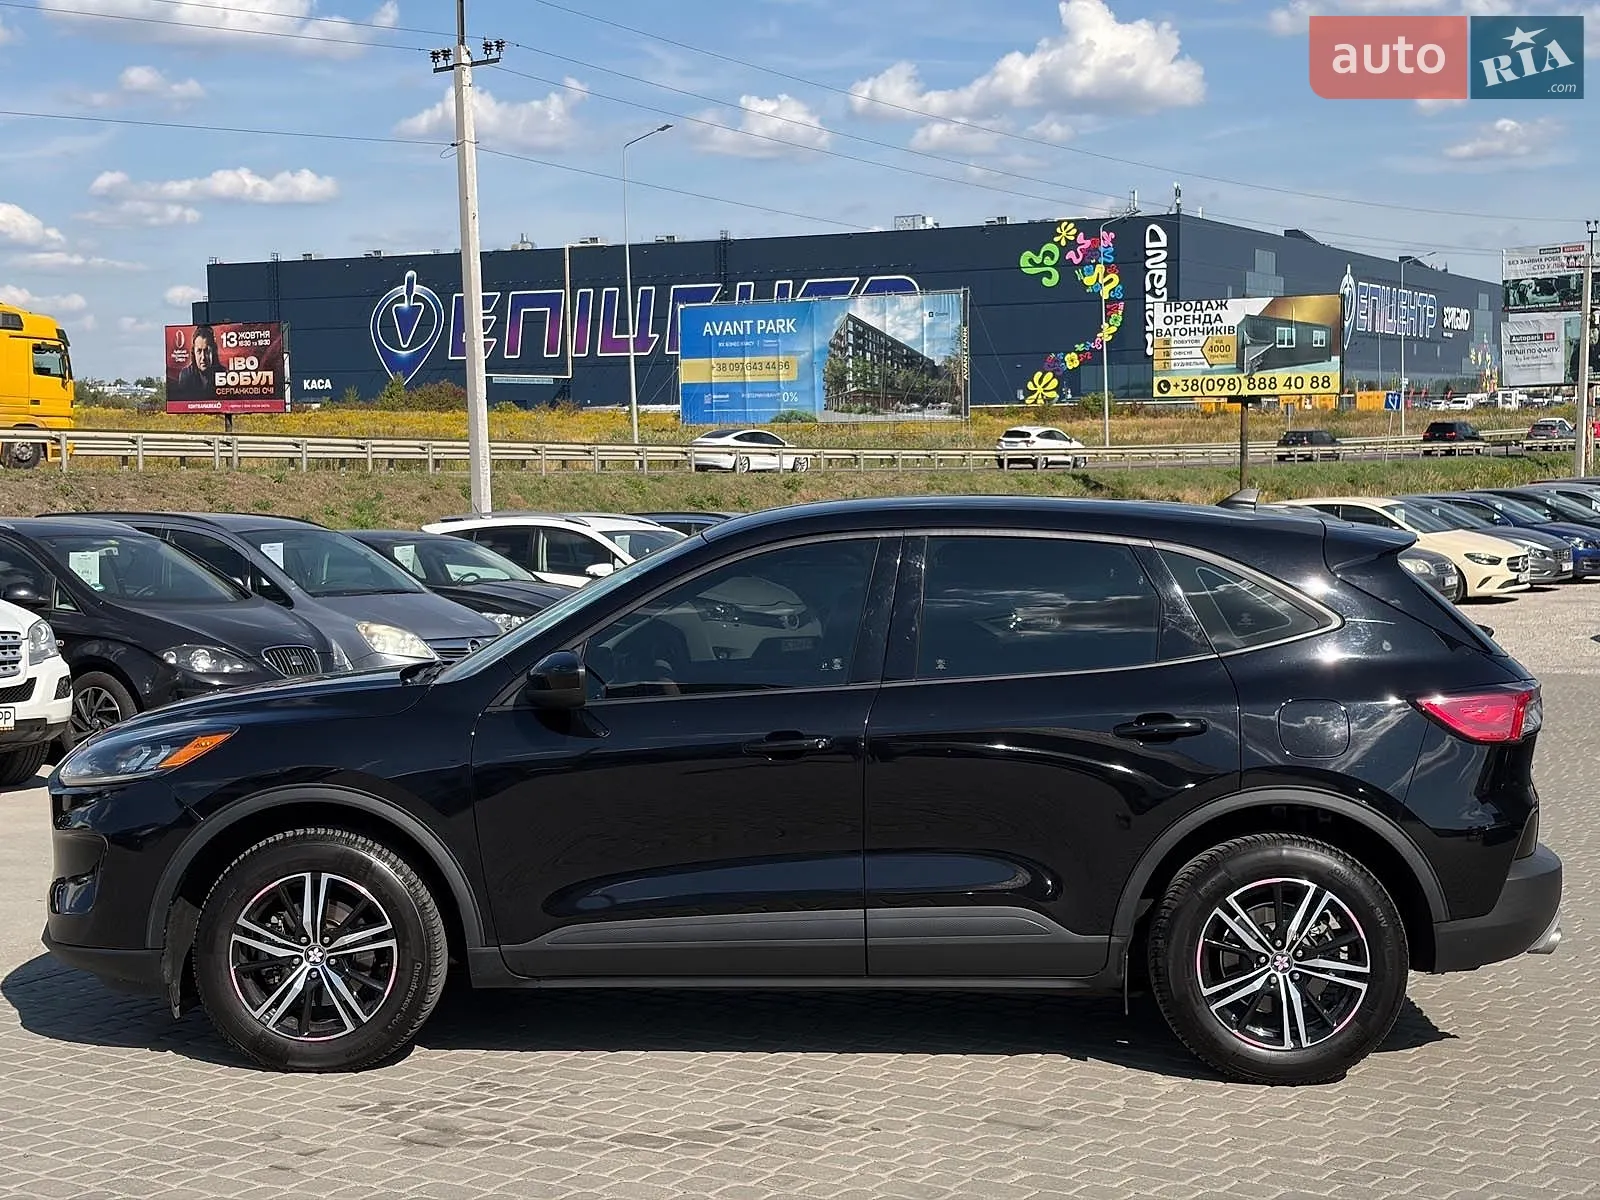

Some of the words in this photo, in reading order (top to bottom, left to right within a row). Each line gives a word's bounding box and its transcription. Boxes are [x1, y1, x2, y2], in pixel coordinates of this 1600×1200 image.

[1163, 300, 1228, 313] ПРОДАЖ
[1356, 281, 1437, 339] ЕПІЦЕНТР
[1163, 313, 1223, 325] ОРЕНДА
[703, 320, 754, 337] AVANT
[757, 317, 797, 335] PARK
[1155, 325, 1236, 338] ВАГОНЧИКІВ
[221, 331, 238, 348] 13
[238, 330, 270, 340] ЖОВТНЯ
[1208, 344, 1230, 353] 4000
[229, 355, 259, 371] ІВО
[729, 361, 744, 372] 097
[745, 360, 763, 372] 643
[764, 360, 777, 371] 44
[214, 370, 274, 387] БОБУЛ
[303, 378, 332, 391] КАСА
[1173, 376, 1242, 395] +38(098)
[1247, 376, 1278, 391] 888
[1283, 376, 1305, 389] 40
[1310, 375, 1331, 389] 88
[216, 387, 261, 395] СЕРПАНКОВІ
[262, 386, 274, 395] ОЧІ
[782, 391, 798, 403] 0%
